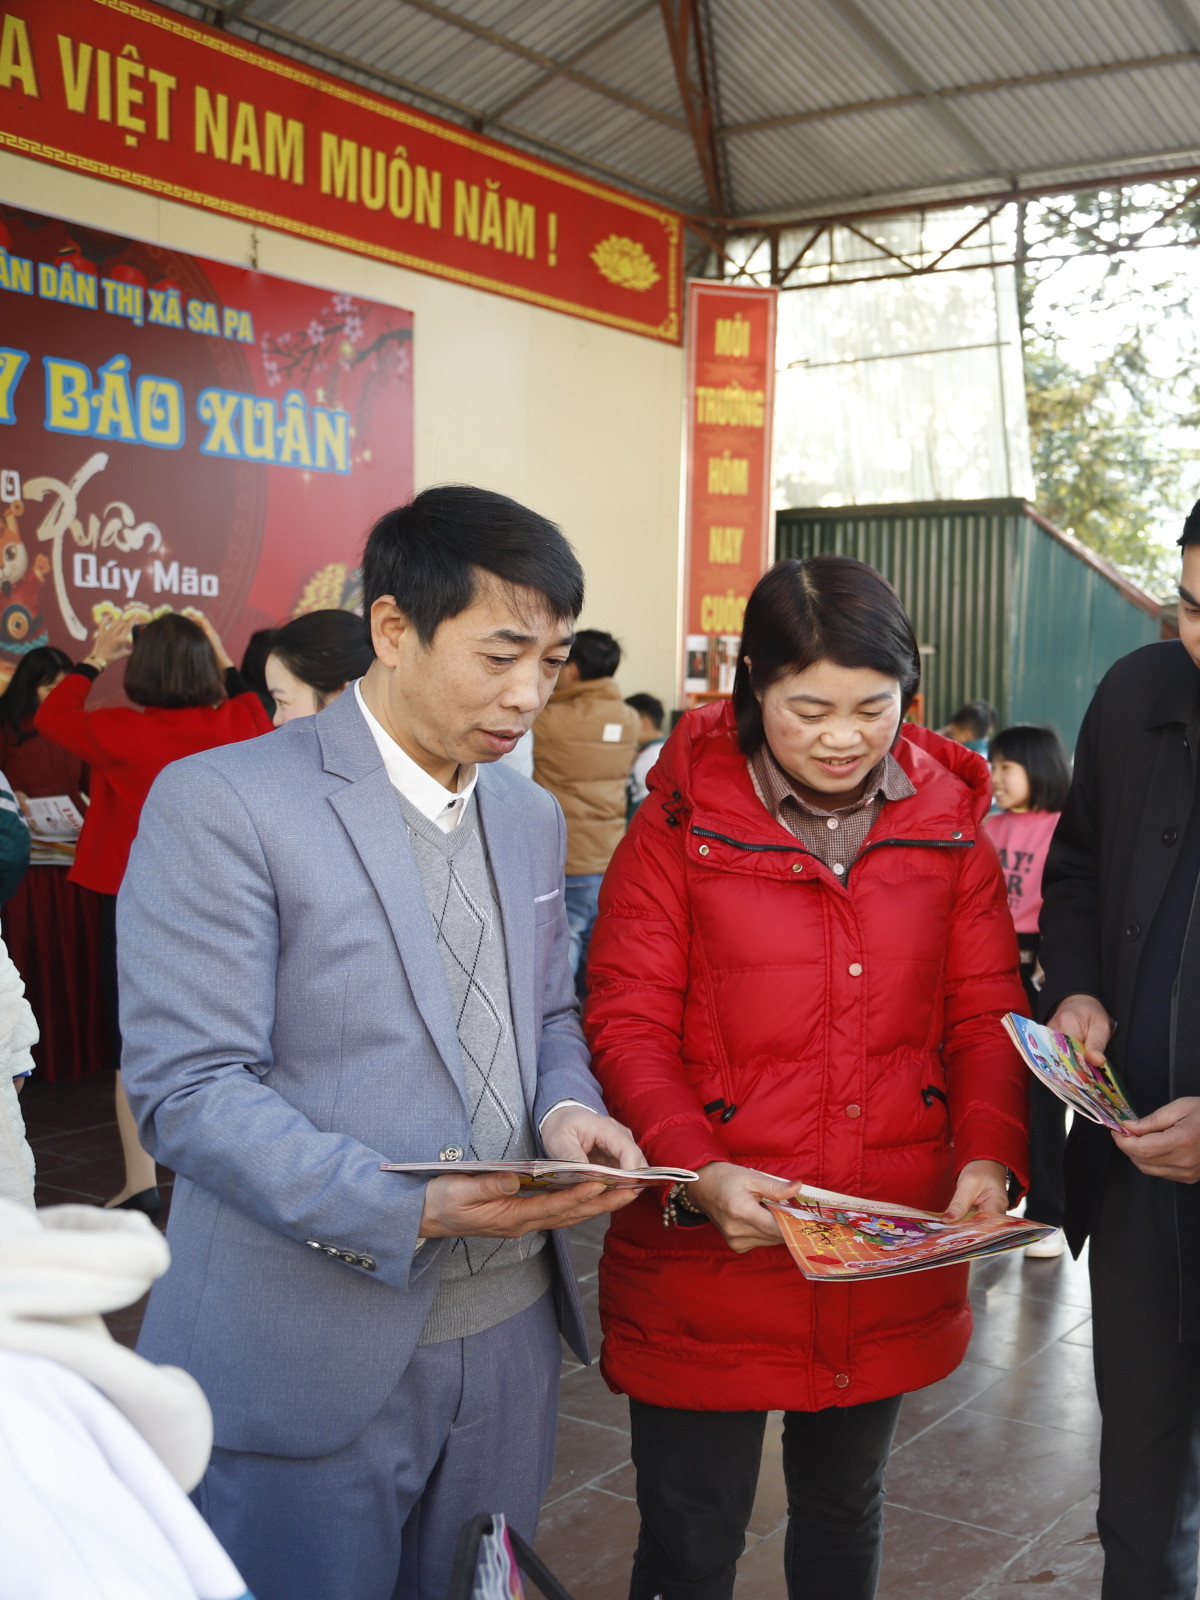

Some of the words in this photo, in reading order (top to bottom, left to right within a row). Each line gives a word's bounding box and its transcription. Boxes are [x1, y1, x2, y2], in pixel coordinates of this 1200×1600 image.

[57, 34, 177, 148] VIỆT
[195, 85, 304, 186] NAM
[320, 131, 442, 230] MUÔN
[453, 178, 537, 261] NĂM
[38, 262, 98, 310] DÂN
[101, 278, 144, 327] THỊ
[148, 286, 183, 330] XÃ
[187, 299, 218, 338] SA
[223, 308, 255, 344] PA
[42, 354, 185, 450] BÁO
[196, 388, 352, 475] XUÂN
[696, 379, 765, 428] TRƯỜNG
[707, 449, 749, 496] HÔM
[708, 526, 745, 565] NAY
[153, 559, 220, 598] Mão
